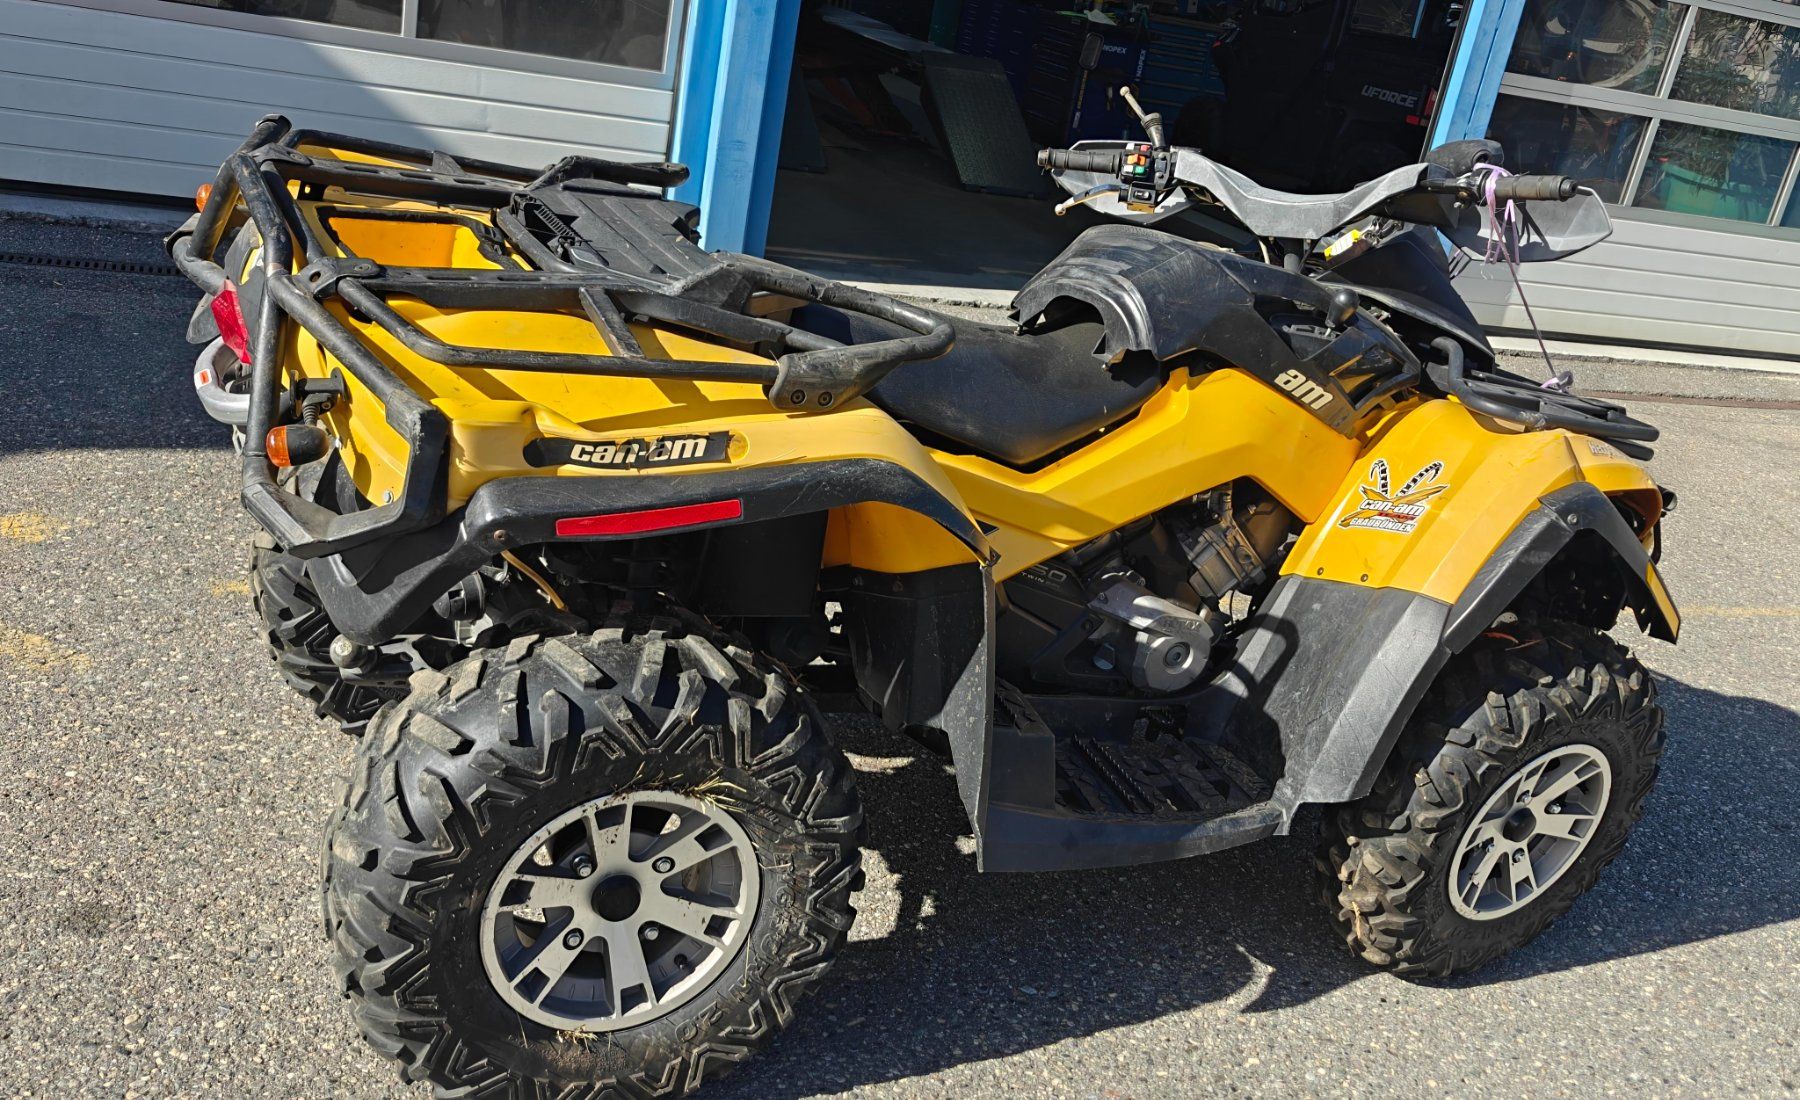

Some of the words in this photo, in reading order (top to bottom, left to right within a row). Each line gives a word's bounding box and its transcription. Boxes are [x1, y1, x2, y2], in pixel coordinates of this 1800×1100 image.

[1361, 85, 1418, 108] UFORCE
[570, 437, 708, 464] can-am
[1359, 499, 1426, 516] can-am
[1028, 564, 1067, 582] 50
